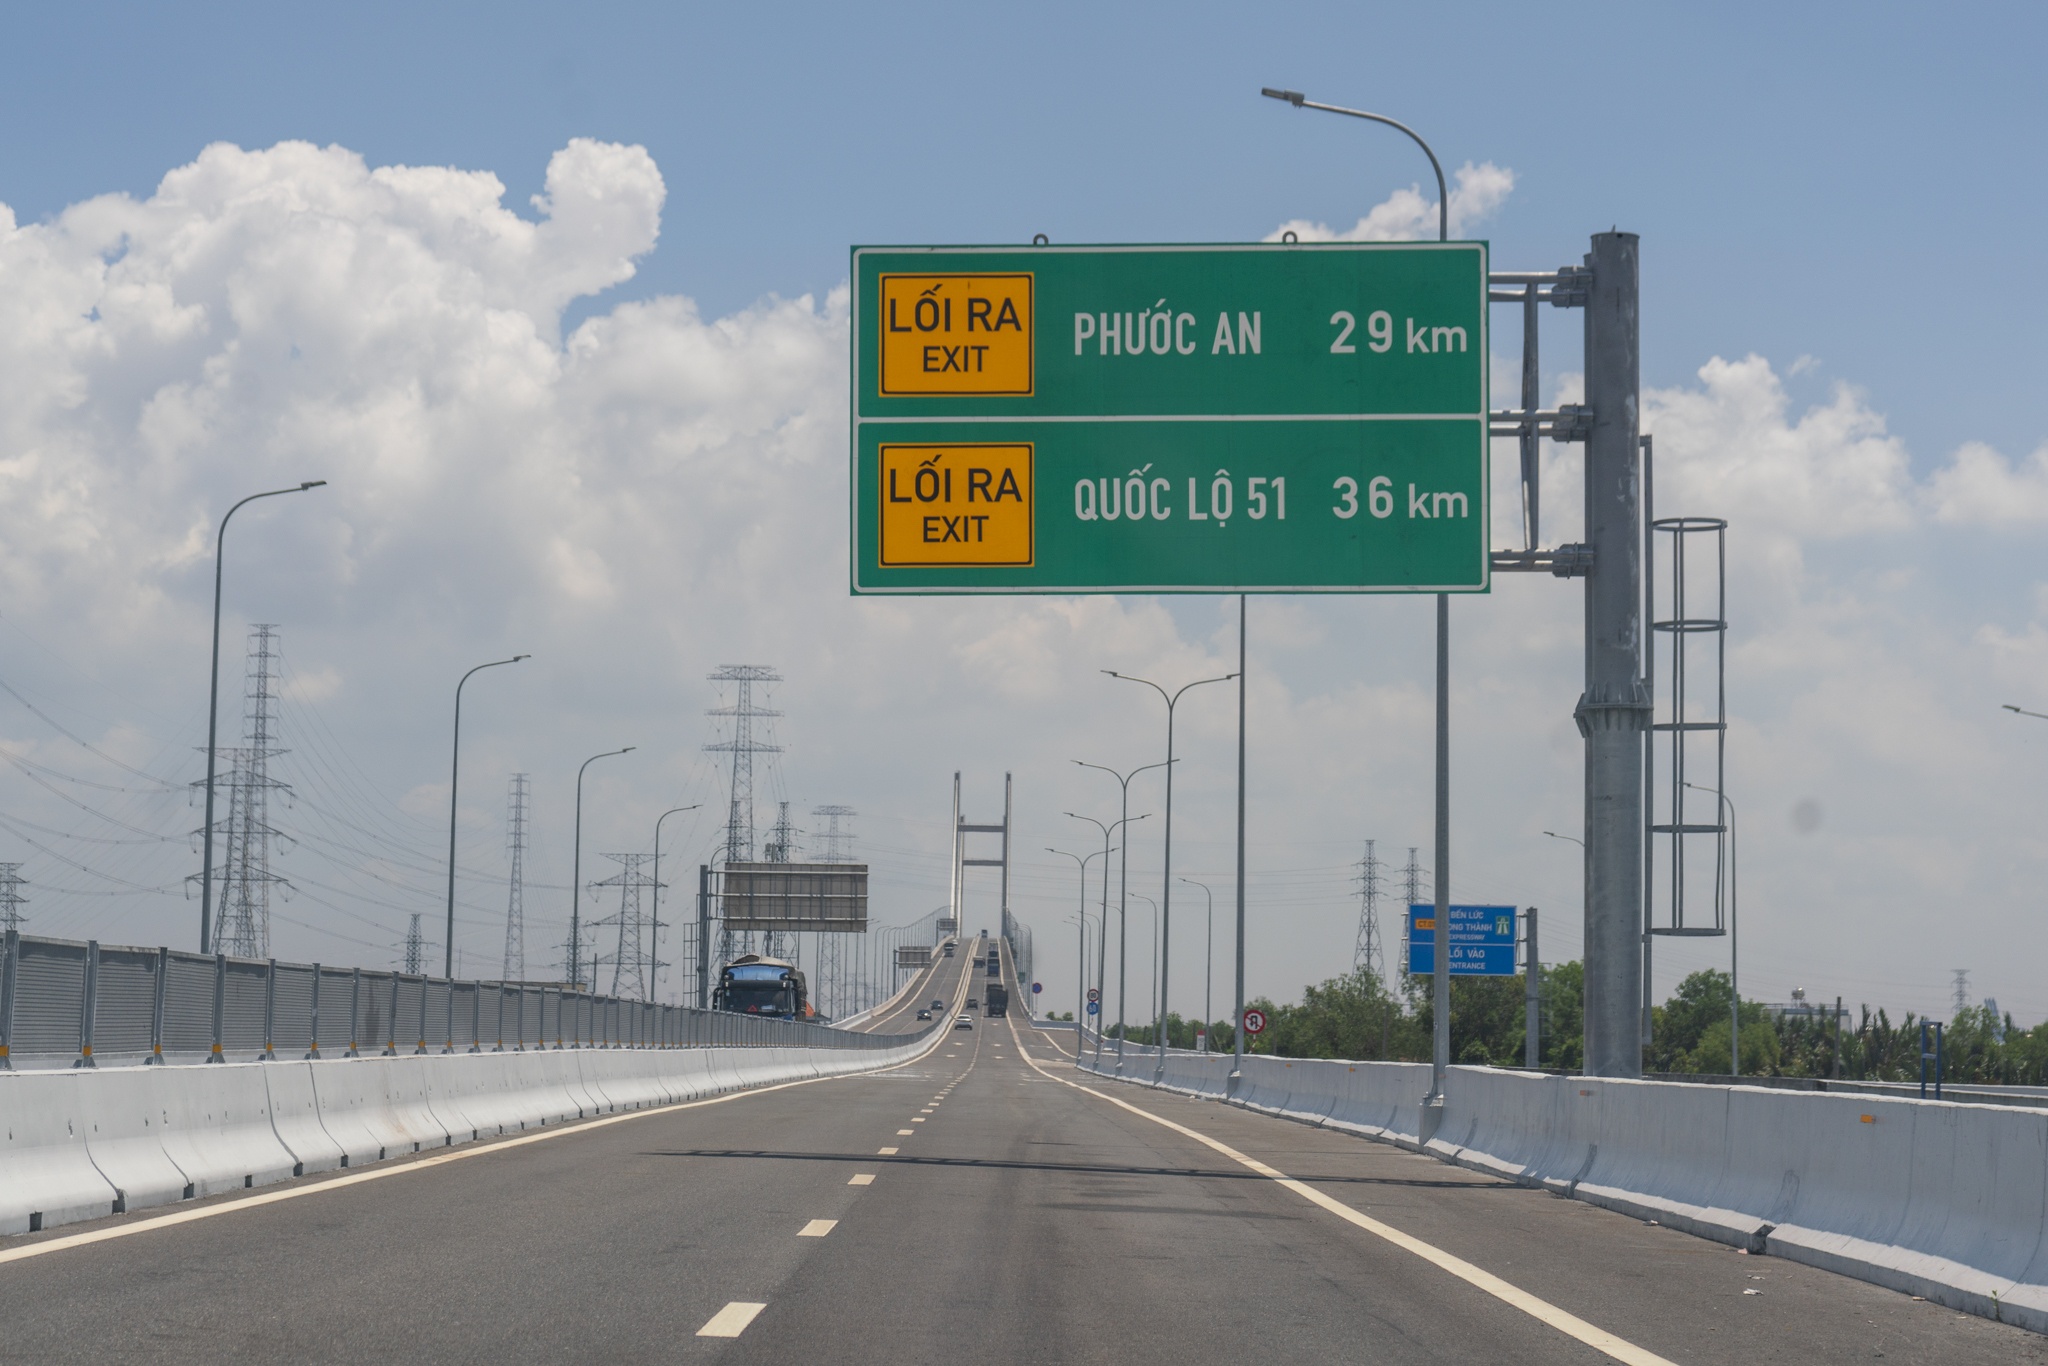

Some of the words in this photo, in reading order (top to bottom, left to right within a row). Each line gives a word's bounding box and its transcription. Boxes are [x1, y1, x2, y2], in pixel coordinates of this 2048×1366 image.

[889, 284, 951, 332] LỐI
[967, 298, 1022, 332] RA
[1074, 298, 1196, 355] PHƯỚC
[1212, 310, 1262, 354] AN
[1329, 310, 1394, 354] 29
[1407, 317, 1468, 354] km
[923, 346, 989, 373] EXIT
[889, 454, 951, 503] LỐI
[967, 468, 1023, 503] RA
[1074, 463, 1171, 521] QUỐC
[1188, 469, 1233, 528] LỘ
[1247, 476, 1286, 520] 51
[1332, 476, 1394, 519] 36
[1408, 482, 1469, 519] km
[923, 515, 989, 543] EXIT
[1466, 922, 1492, 931] THÀNH
[1449, 946, 1462, 958] LỐI
[1467, 947, 1485, 958] VÀO
